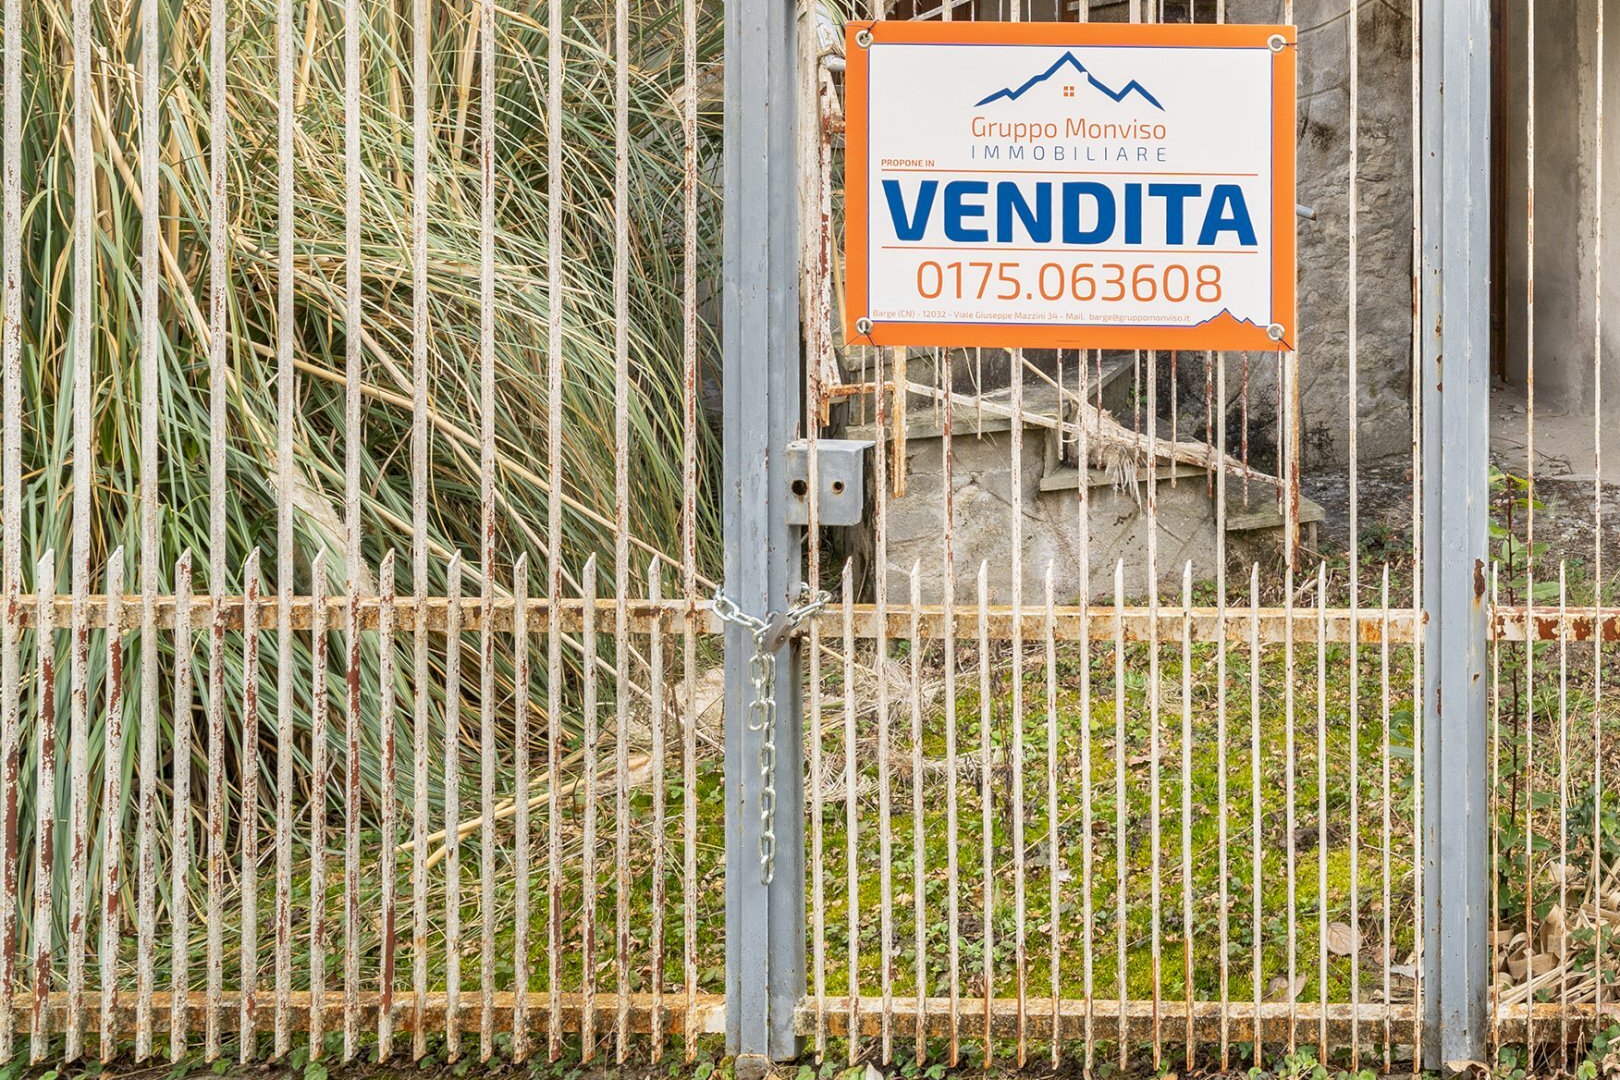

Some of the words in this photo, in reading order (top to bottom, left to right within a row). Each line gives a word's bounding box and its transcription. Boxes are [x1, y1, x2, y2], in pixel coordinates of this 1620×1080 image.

[971, 116, 1058, 143] Gruppo
[1065, 118, 1167, 140] Monviso
[881, 159, 923, 167] PROPONE
[971, 145, 1167, 162] IMMOBILIARE
[881, 180, 1258, 246] VENDITA
[916, 261, 1223, 303] 0175.063608
[873, 310, 896, 318] Barge
[898, 310, 915, 319] (CN)
[923, 310, 946, 318] 12032
[954, 311, 974, 319] Viale
[976, 311, 1012, 320] Giuseppe
[1089, 313, 1190, 322] barge@gruppomonviso.it
